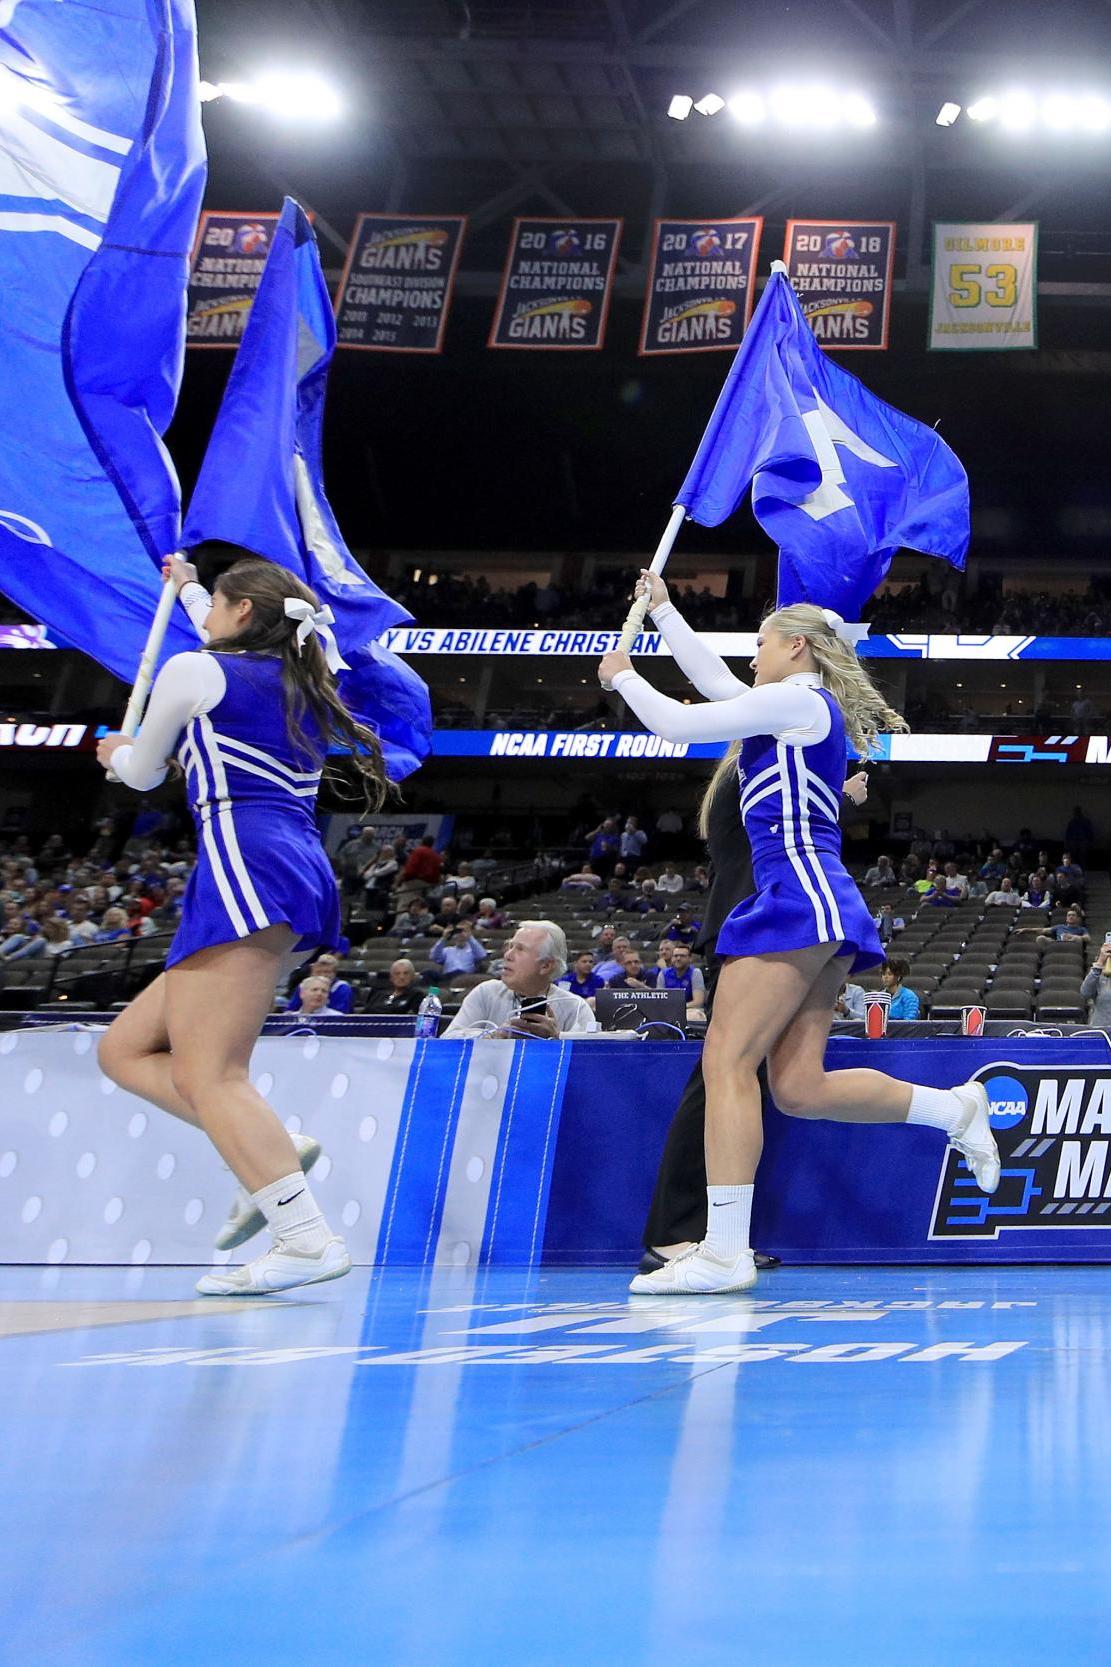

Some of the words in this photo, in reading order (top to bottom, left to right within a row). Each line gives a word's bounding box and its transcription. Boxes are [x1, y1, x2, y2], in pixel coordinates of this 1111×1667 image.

[204, 227, 235, 246] 20
[519, 232, 547, 249] 20
[584, 233, 607, 250] 16
[662, 234, 688, 252] 20
[724, 233, 748, 249] 17
[796, 235, 821, 252] 20
[860, 236, 881, 253] 18
[943, 237, 1025, 252] GILMORE
[361, 240, 442, 270] GIANTS
[518, 261, 600, 275] NATIONAL
[662, 261, 743, 276] NATIONAL
[797, 263, 878, 277] NATIONAL
[509, 275, 606, 290] CHAMPIONS
[655, 275, 747, 292] CHAMPIONS
[790, 278, 883, 293] CHAMPIONS
[949, 264, 1018, 308] 53
[346, 286, 443, 309] CHAMPIONS
[508, 311, 587, 338] GIANTS
[657, 314, 732, 342] GIANTS
[405, 631, 434, 650] VS
[439, 632, 533, 651] ABILENE
[539, 633, 662, 653] CHRISTAN
[489, 733, 548, 756] NCAA
[550, 734, 615, 757] FIRST
[353, 1341, 1030, 1364] HOSTED
